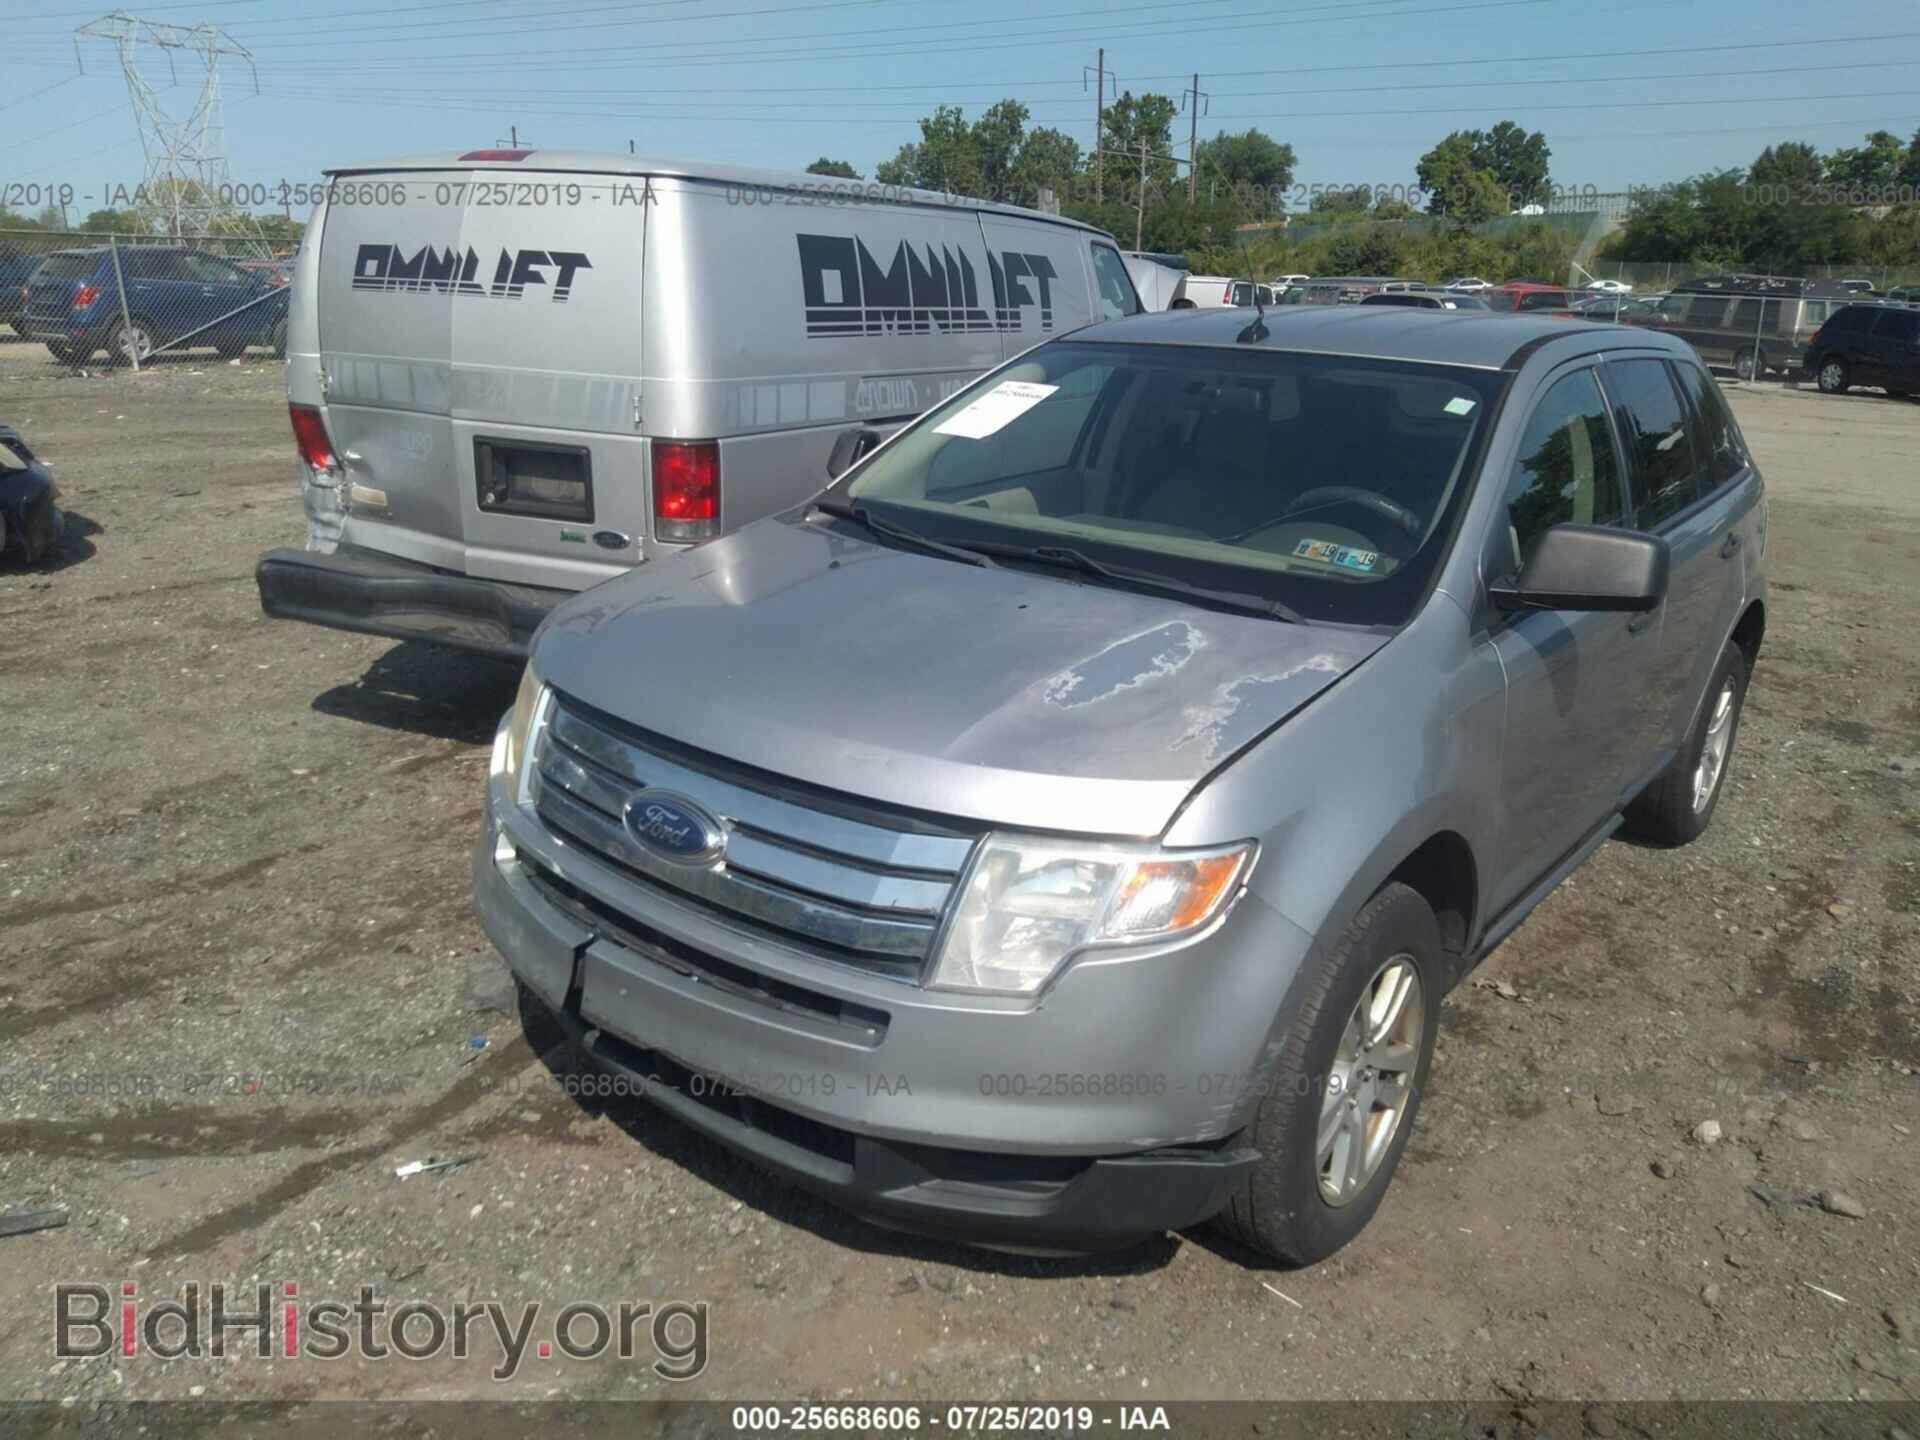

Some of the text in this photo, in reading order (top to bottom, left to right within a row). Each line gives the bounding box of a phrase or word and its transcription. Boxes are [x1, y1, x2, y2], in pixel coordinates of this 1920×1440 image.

[352, 240, 593, 304] OMNILIFT
[796, 233, 1058, 338] OMNILIFT
[638, 804, 691, 847] Ford
